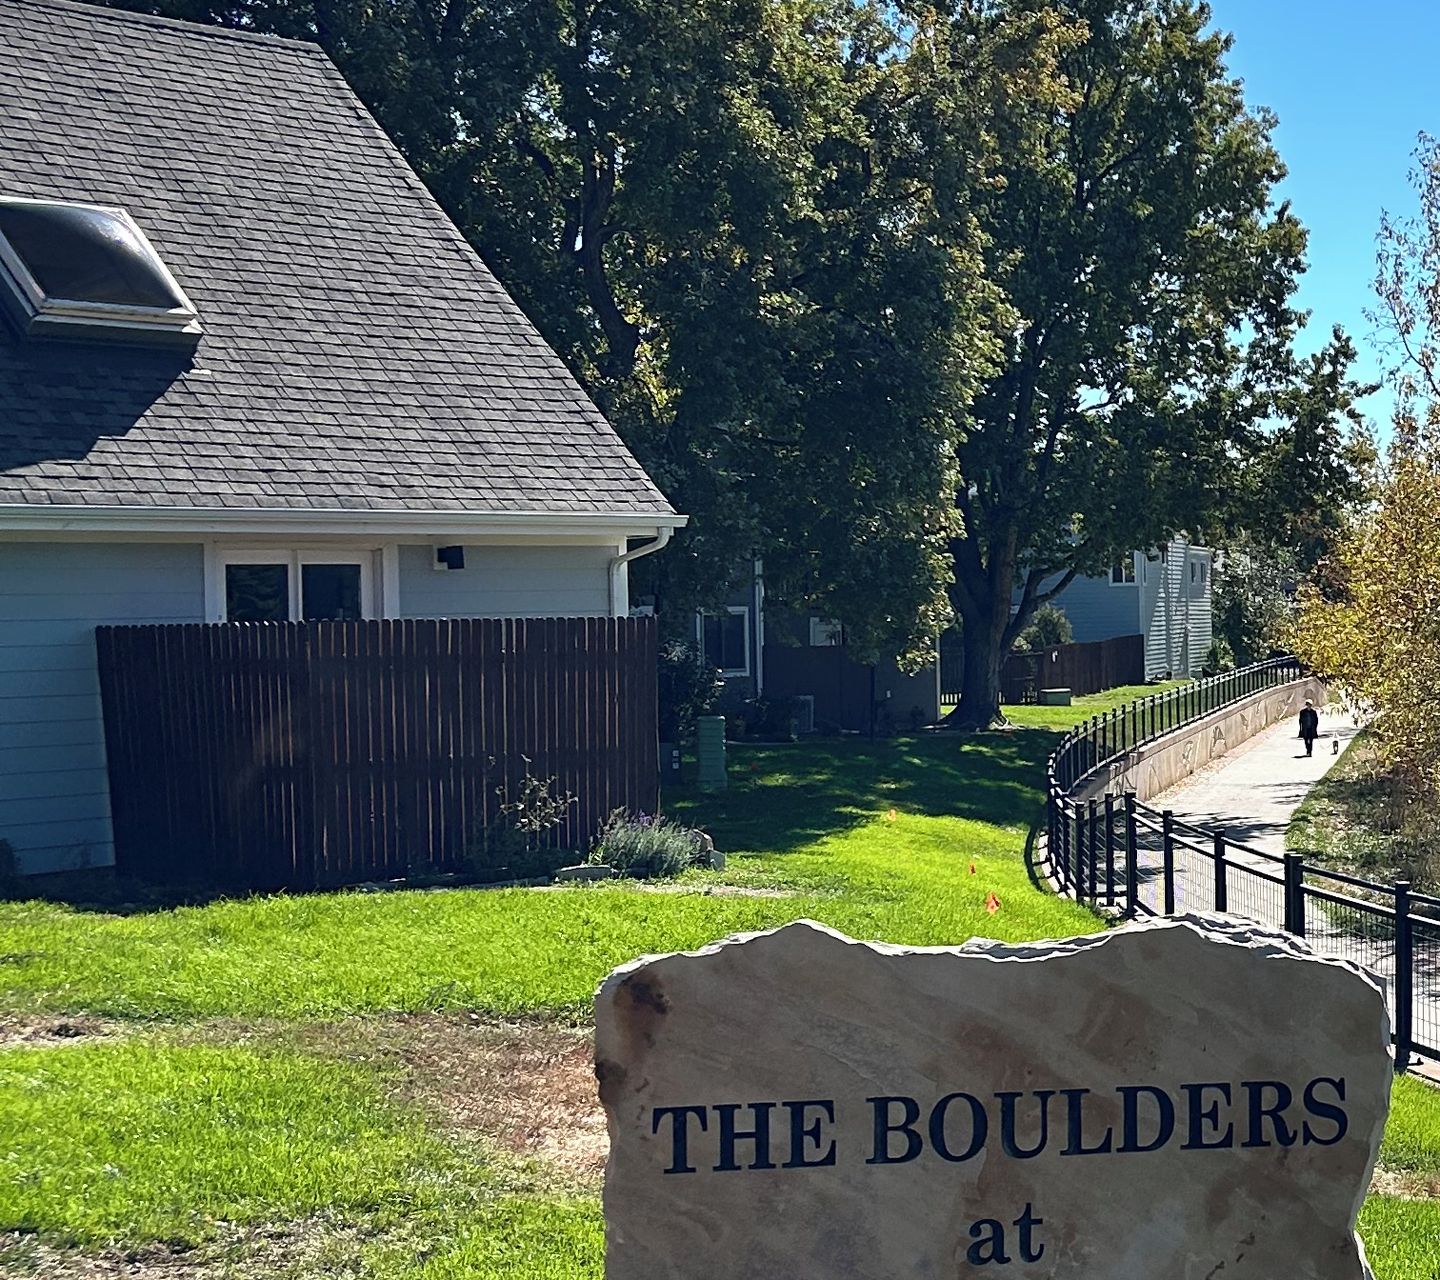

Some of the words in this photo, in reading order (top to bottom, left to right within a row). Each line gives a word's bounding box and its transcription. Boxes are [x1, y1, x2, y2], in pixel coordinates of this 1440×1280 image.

[652, 1100, 836, 1174] THE
[866, 1077, 1348, 1165] BOULDERS
[966, 1203, 1044, 1265] at
